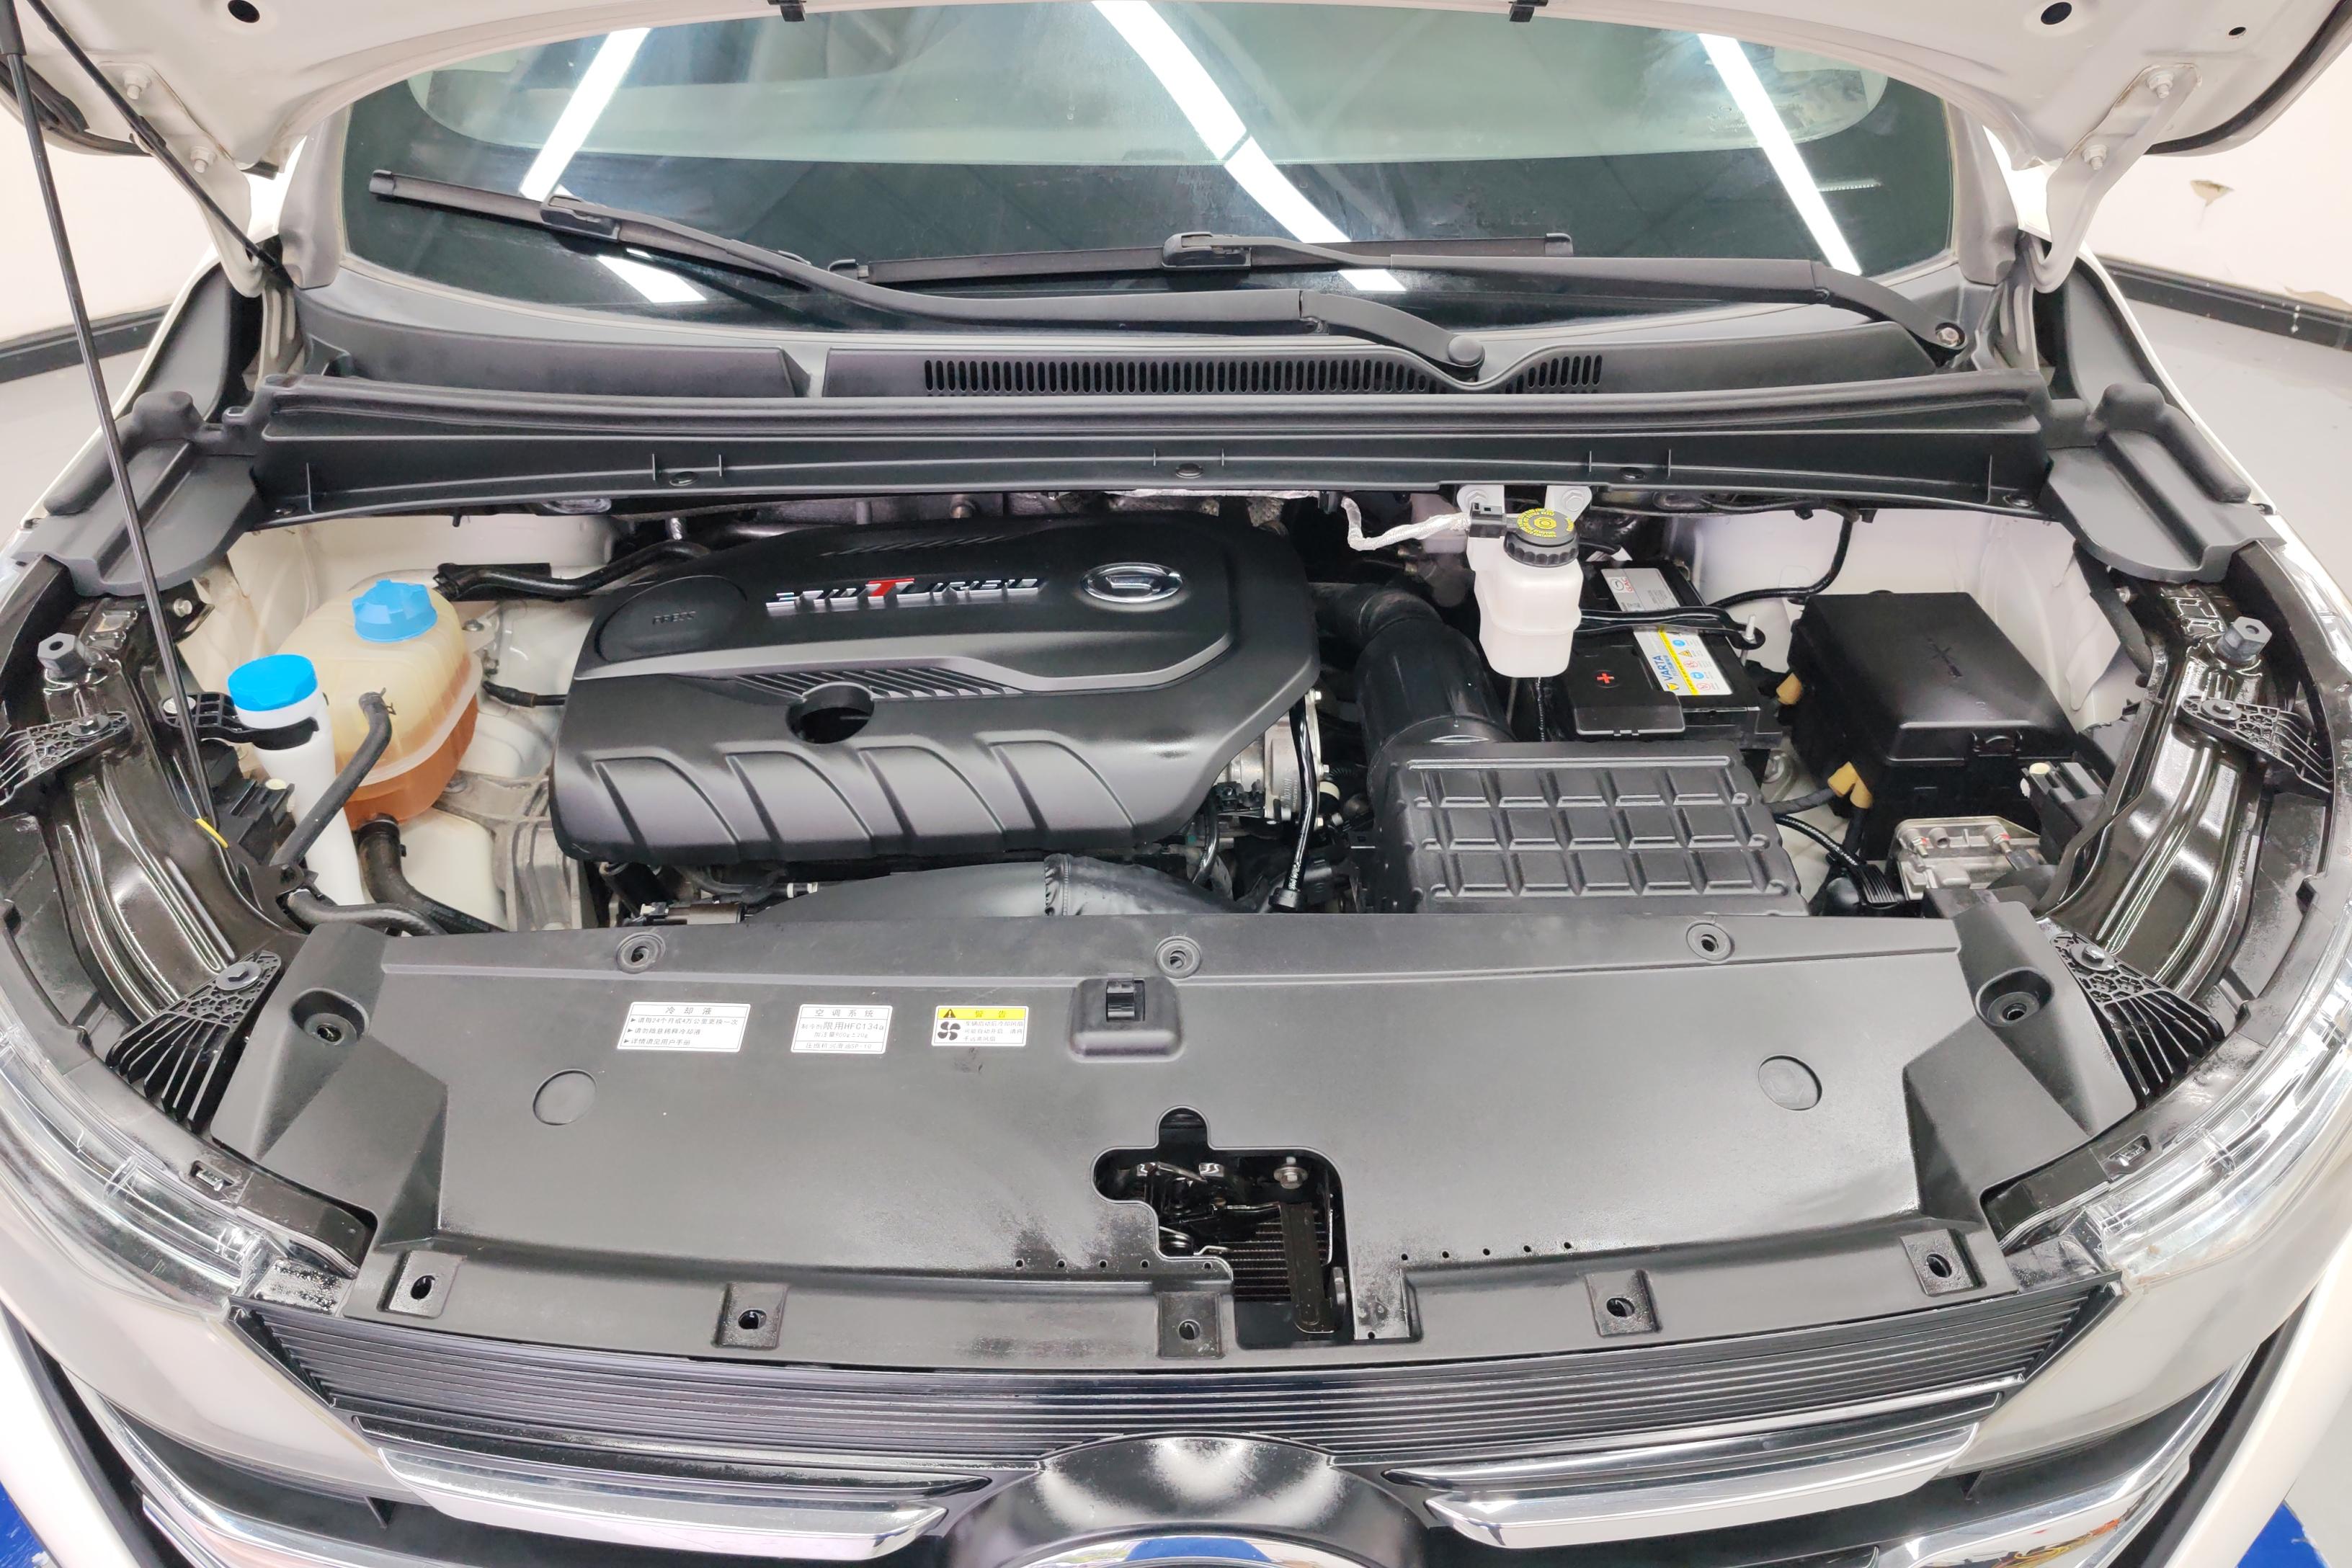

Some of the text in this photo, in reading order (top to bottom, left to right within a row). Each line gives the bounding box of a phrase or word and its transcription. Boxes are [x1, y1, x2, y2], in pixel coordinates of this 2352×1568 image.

[1622, 577, 1634, 592] GAC
[1652, 655, 1674, 681] VARTA
[665, 1006, 713, 1015] 冷却液
[814, 1009, 874, 1017] 空调系统
